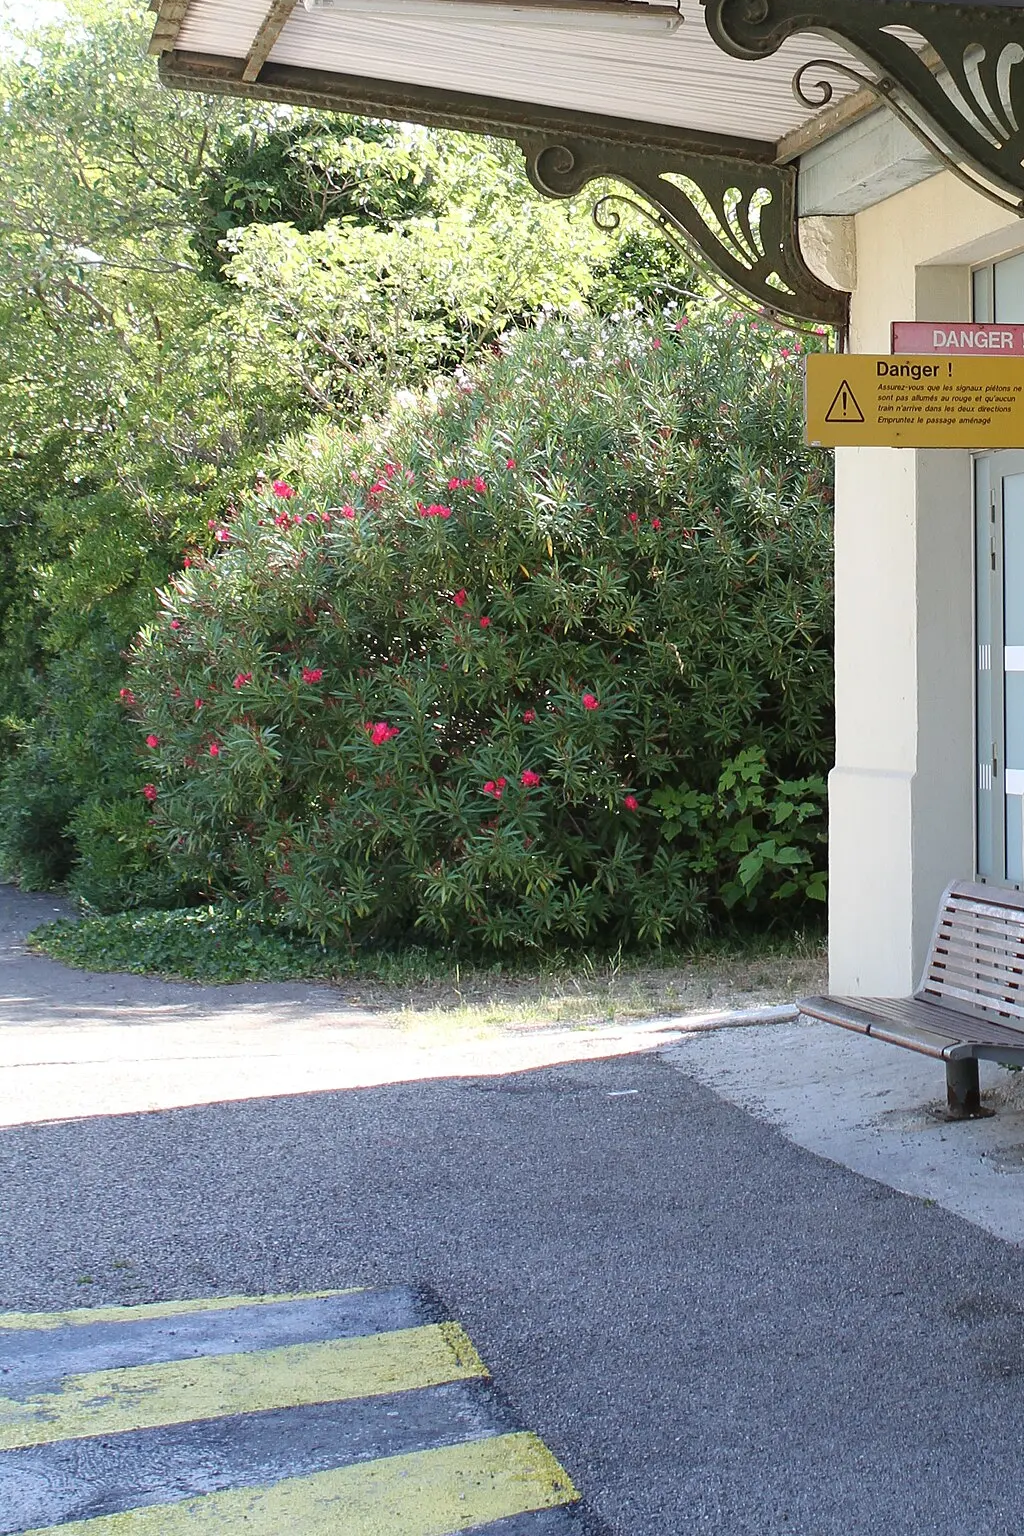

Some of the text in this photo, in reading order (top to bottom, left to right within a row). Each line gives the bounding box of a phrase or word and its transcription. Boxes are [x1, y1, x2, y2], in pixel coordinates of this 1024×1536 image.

[932, 330, 1014, 349] DANGER
[876, 361, 940, 381] Danger
[926, 385, 941, 393] que
[942, 384, 953, 392] les
[955, 384, 983, 393] signaux
[985, 384, 1011, 393] piétons
[877, 394, 893, 402] sont
[895, 395, 909, 403] pas
[911, 394, 938, 402] allumés
[951, 395, 973, 404] rouge
[924, 405, 942, 413] dans
[944, 405, 955, 413] les
[957, 405, 975, 413] deux
[977, 405, 1012, 413] directions
[877, 416, 992, 426] Empruntez le passage aménagé
